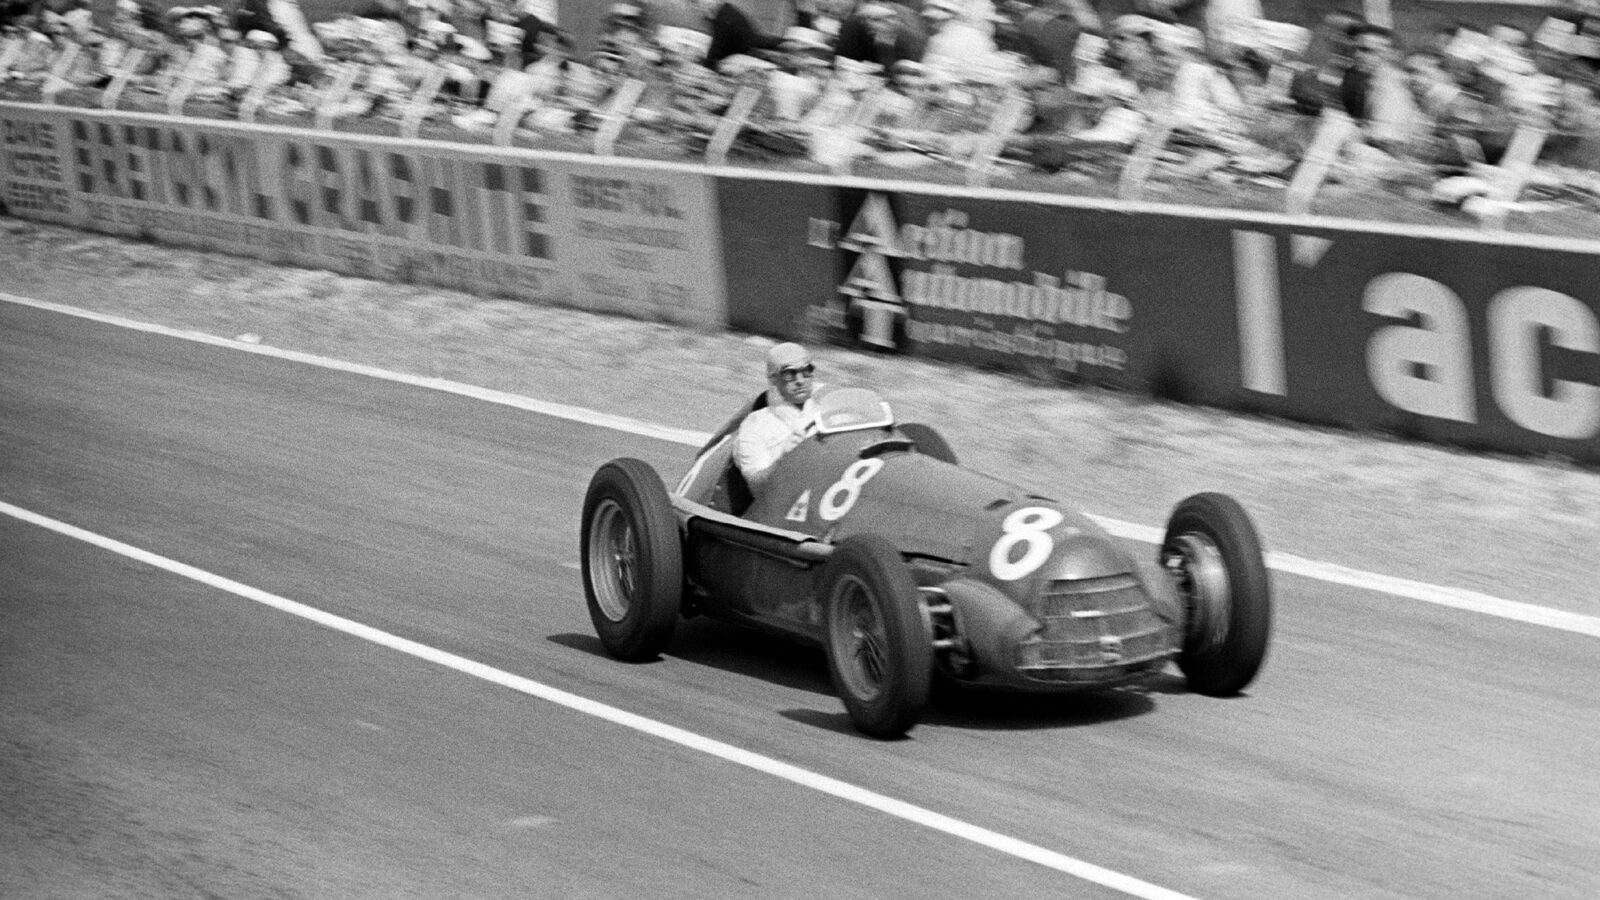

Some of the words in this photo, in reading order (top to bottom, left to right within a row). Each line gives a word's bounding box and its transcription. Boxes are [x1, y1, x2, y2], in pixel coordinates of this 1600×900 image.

[837, 252, 1133, 333] Automobile
[819, 458, 885, 521] 8
[989, 506, 1063, 581] 8
